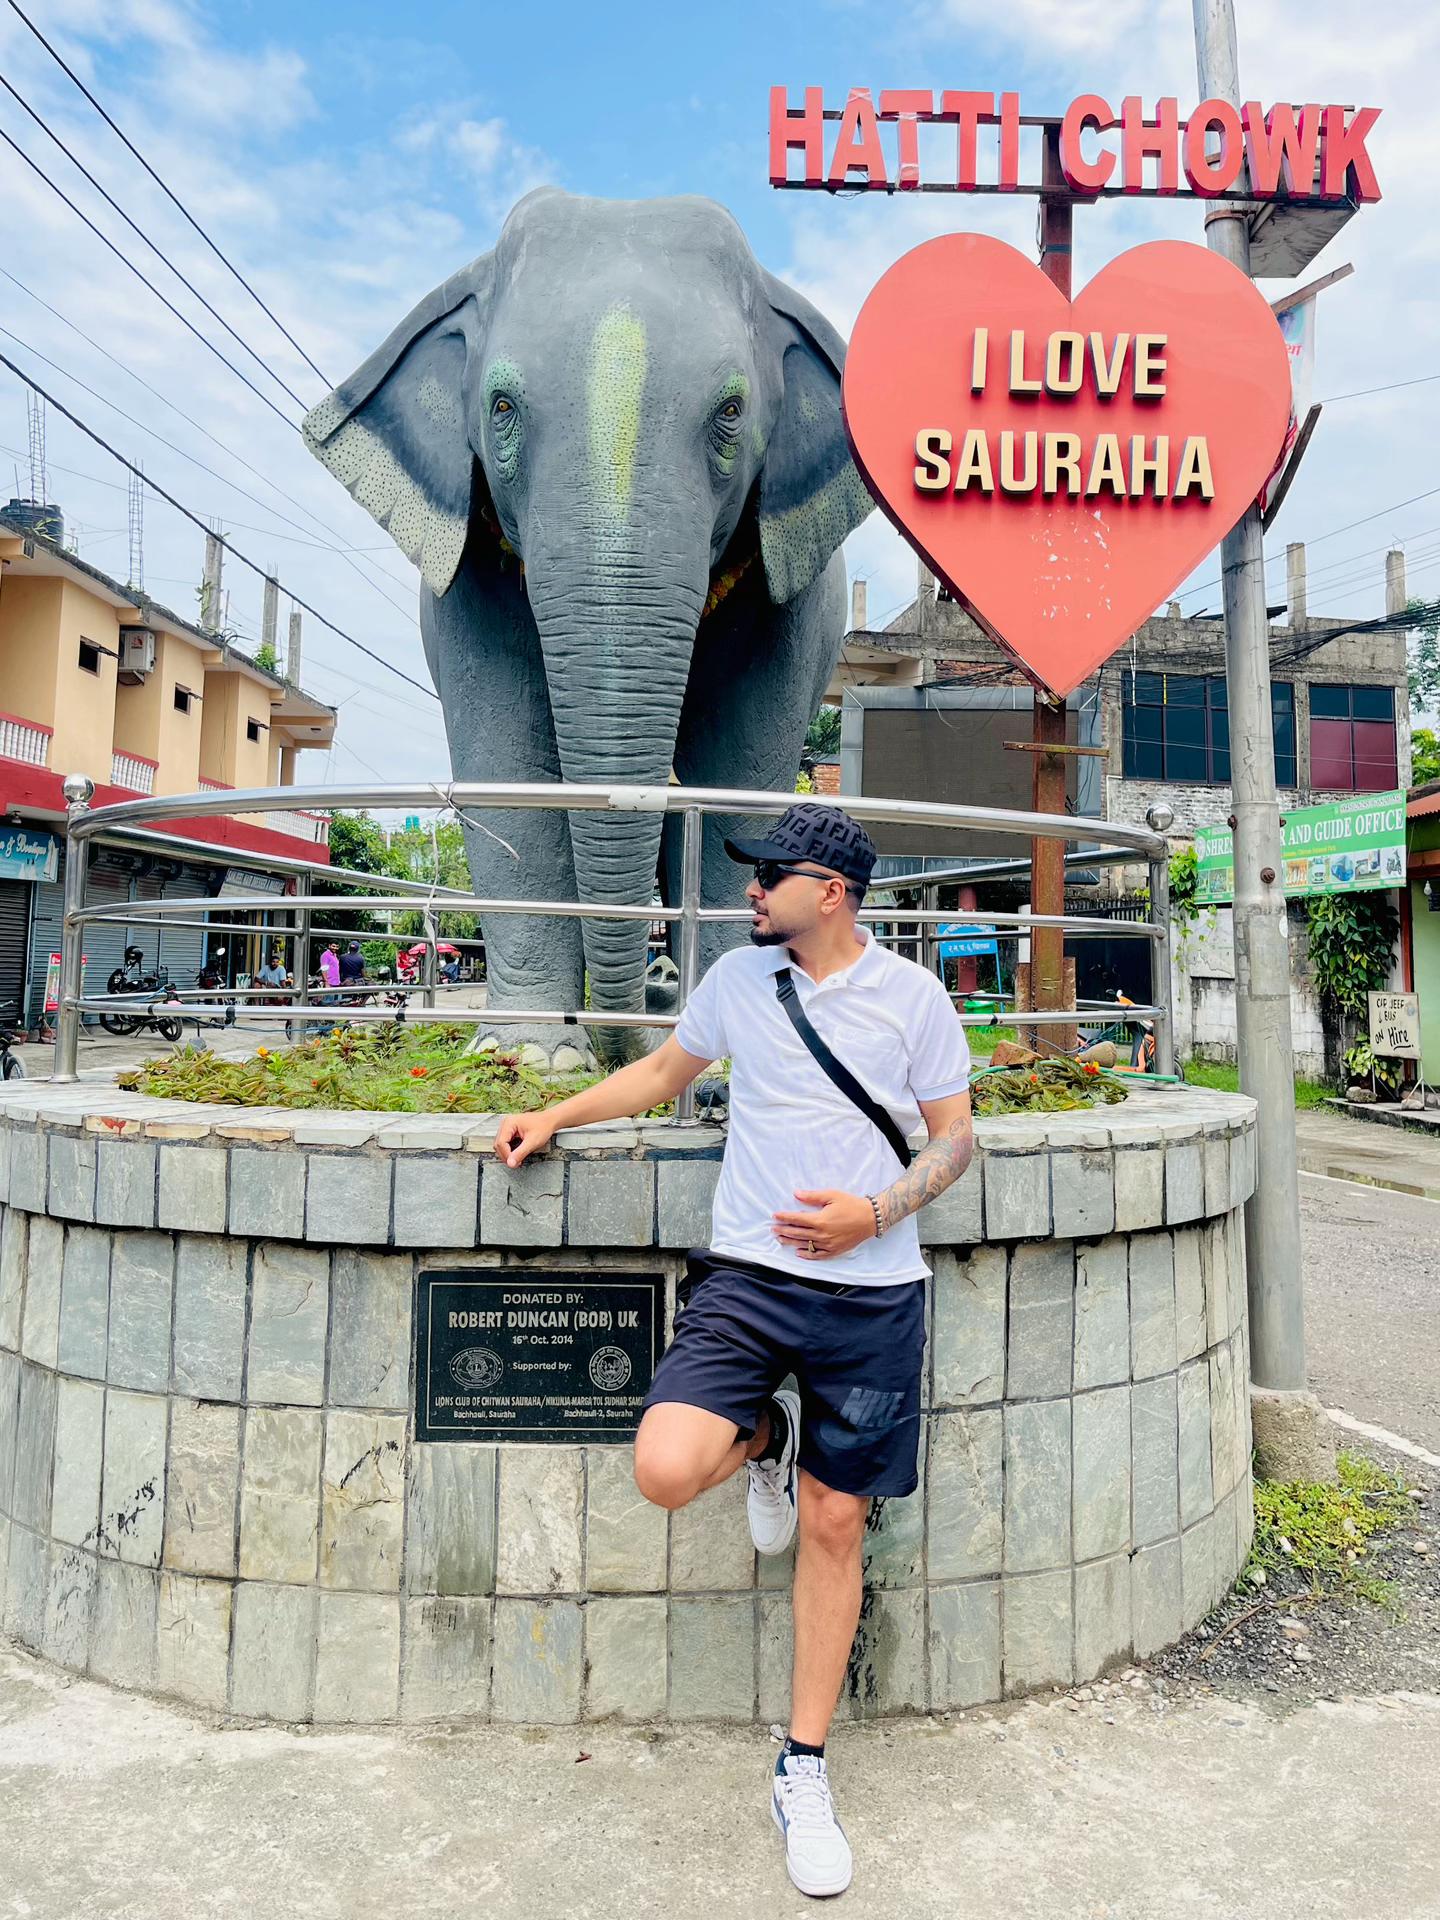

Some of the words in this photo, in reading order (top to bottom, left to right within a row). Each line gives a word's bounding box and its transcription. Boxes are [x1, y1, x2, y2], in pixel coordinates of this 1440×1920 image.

[769, 86, 1020, 191] HATTI
[1058, 93, 1383, 204] CHOWK
[971, 327, 988, 394] I
[1008, 329, 1168, 400] LOVE
[913, 428, 1216, 501] SAURAHA
[1288, 823, 1311, 846] AND
[1314, 816, 1352, 842] GUIDE
[1355, 808, 1404, 836] OFFICE
[502, 1293, 563, 1305] DONATED
[566, 1293, 585, 1305] BY:
[448, 1311, 503, 1329] ROBERT
[507, 1311, 569, 1329] DUNCAN
[573, 1310, 613, 1332] (BOB)
[617, 1311, 639, 1328] UK
[530, 1335, 550, 1345] Oct.
[551, 1335, 574, 1345] 2014
[512, 1361, 556, 1373] Supported
[558, 1361, 573, 1372] by:
[435, 1396, 453, 1407] LIONS
[455, 1396, 470, 1407] CLUB
[471, 1396, 480, 1407] OF
[481, 1396, 510, 1407] CHITWAN
[489, 1411, 516, 1419] Sauraha
[606, 1410, 634, 1418] Sauraha
